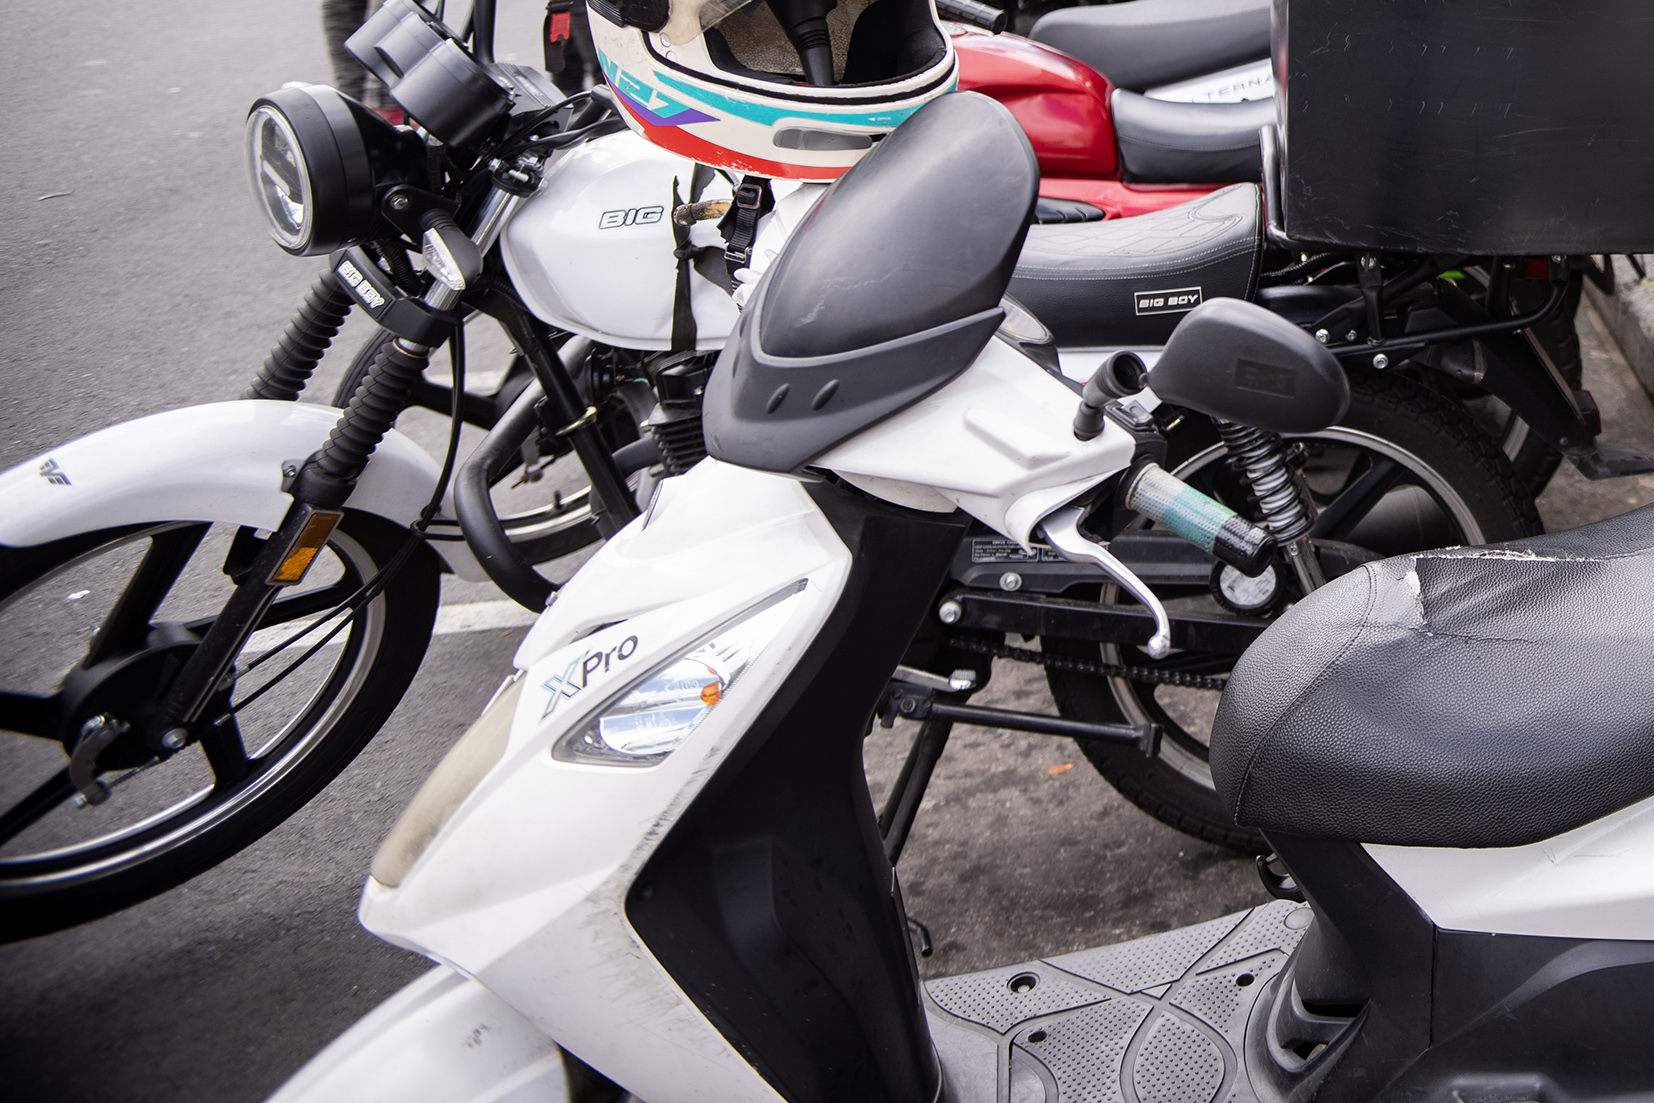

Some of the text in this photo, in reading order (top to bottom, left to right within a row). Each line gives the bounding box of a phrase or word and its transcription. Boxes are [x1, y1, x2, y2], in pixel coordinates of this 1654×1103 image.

[599, 205, 664, 230] BIG
[337, 260, 385, 309] BIG BOY
[1138, 294, 1199, 308] BIG BOY
